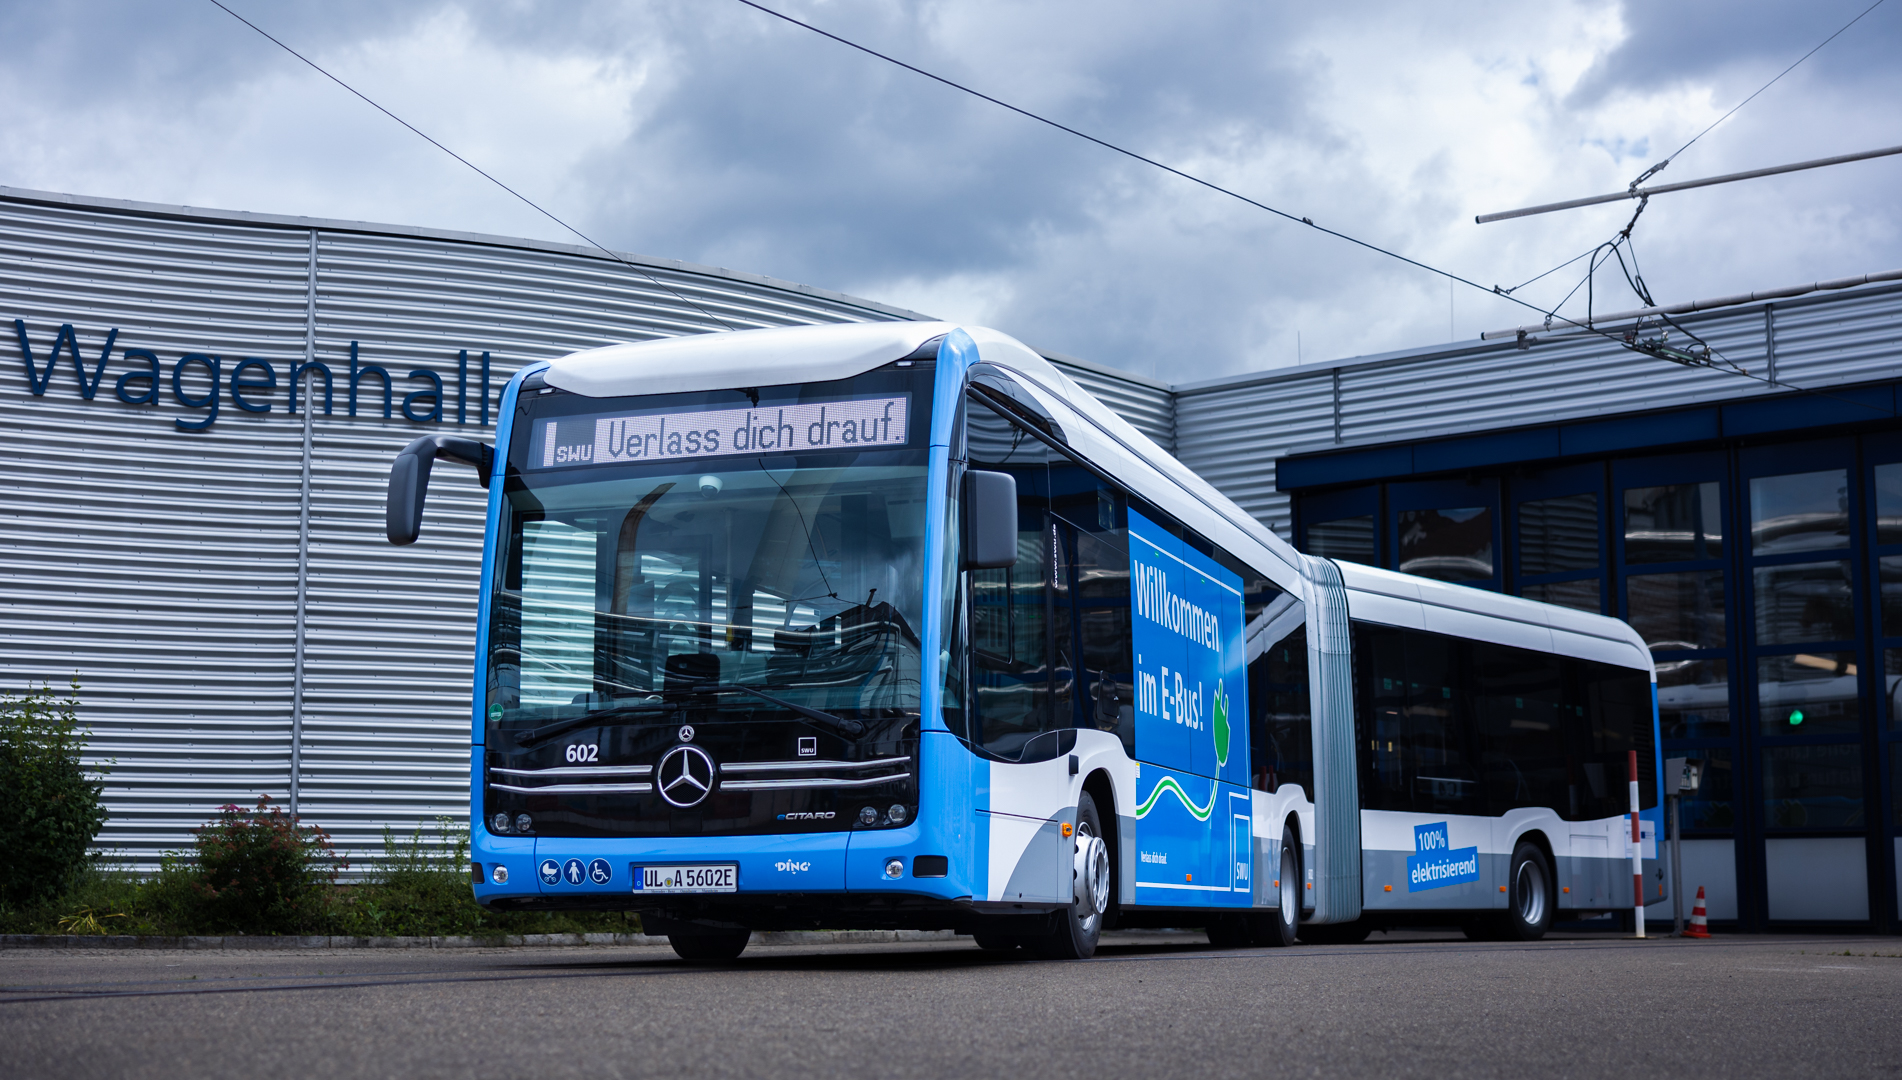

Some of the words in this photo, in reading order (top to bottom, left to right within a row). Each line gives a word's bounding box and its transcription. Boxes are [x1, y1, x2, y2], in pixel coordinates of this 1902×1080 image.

[15, 319, 505, 432] Wagenhall
[608, 418, 720, 458] Verlass
[733, 409, 793, 450] dich
[808, 401, 904, 446] drauf.
[556, 443, 592, 463] SWU
[1134, 559, 1219, 652] Willkommen
[1138, 654, 1158, 716] im
[1161, 665, 1204, 731] E-Bus!
[566, 744, 598, 763] 602
[777, 812, 835, 820] eCITARO
[1418, 829, 1446, 851] 100%
[777, 862, 809, 872] DING
[1236, 862, 1248, 880] SWU
[1411, 854, 1476, 884] elektrisierend
[645, 870, 663, 887] UL
[674, 870, 683, 887] A
[686, 869, 733, 887] 5602E
